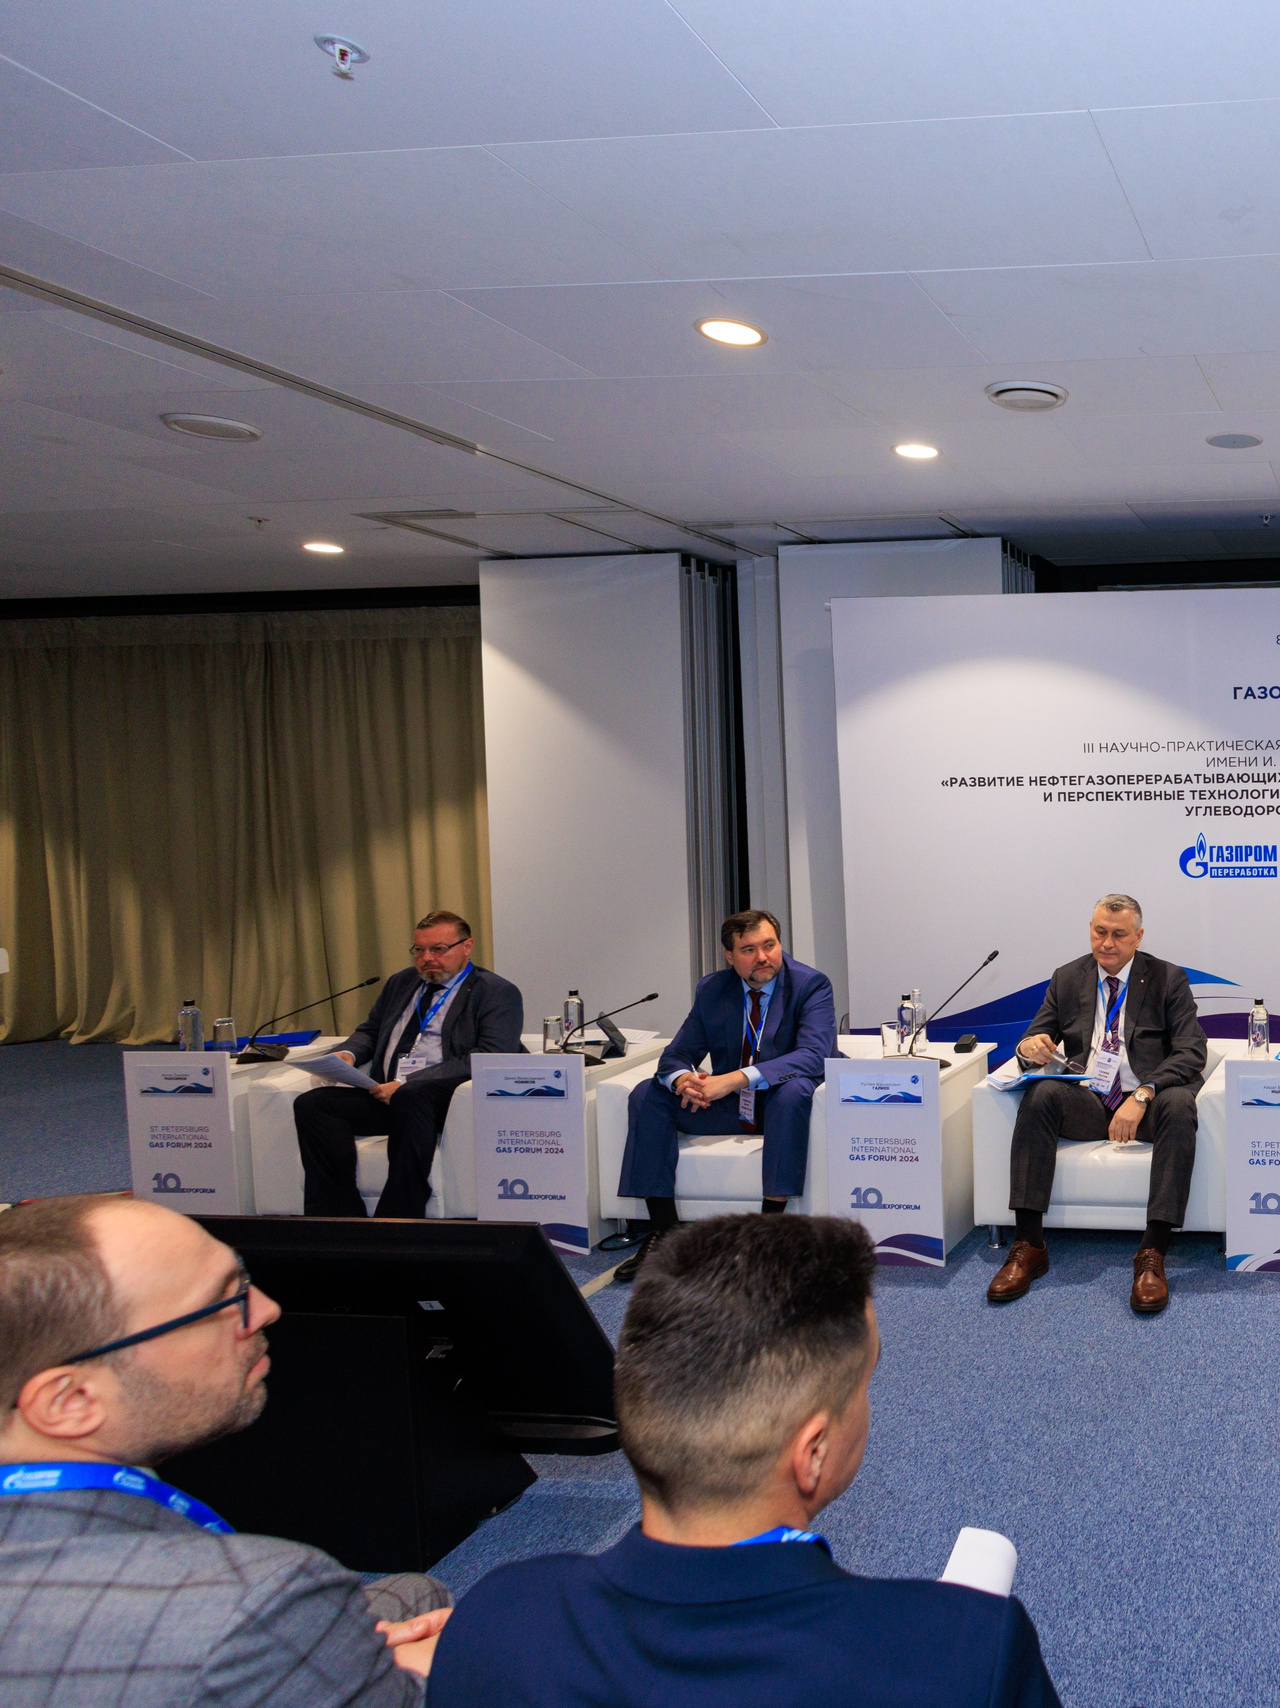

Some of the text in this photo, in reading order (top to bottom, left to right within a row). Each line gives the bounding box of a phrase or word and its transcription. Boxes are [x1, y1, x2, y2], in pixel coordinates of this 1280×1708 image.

[1083, 743, 1094, 754] III
[1206, 756, 1258, 768] ИМЕНИ
[1263, 756, 1276, 767] И.
[941, 776, 1024, 788] «РАЗВИТИЕ
[1043, 792, 1053, 802] И
[1058, 790, 1185, 802] ПЕРСПЕКТИВНЫЕ
[1209, 845, 1278, 862] ГАЗПРОМ
[1211, 867, 1276, 877] ПЕРЕРАБОТКА
[510, 1130, 562, 1138] PETERSBURG
[498, 1138, 560, 1146] INTERNATIONAL
[851, 1137, 917, 1146] ST. PETERSBURG
[851, 1146, 915, 1154] INTERNATIONAL
[1248, 1158, 1267, 1166] GAS
